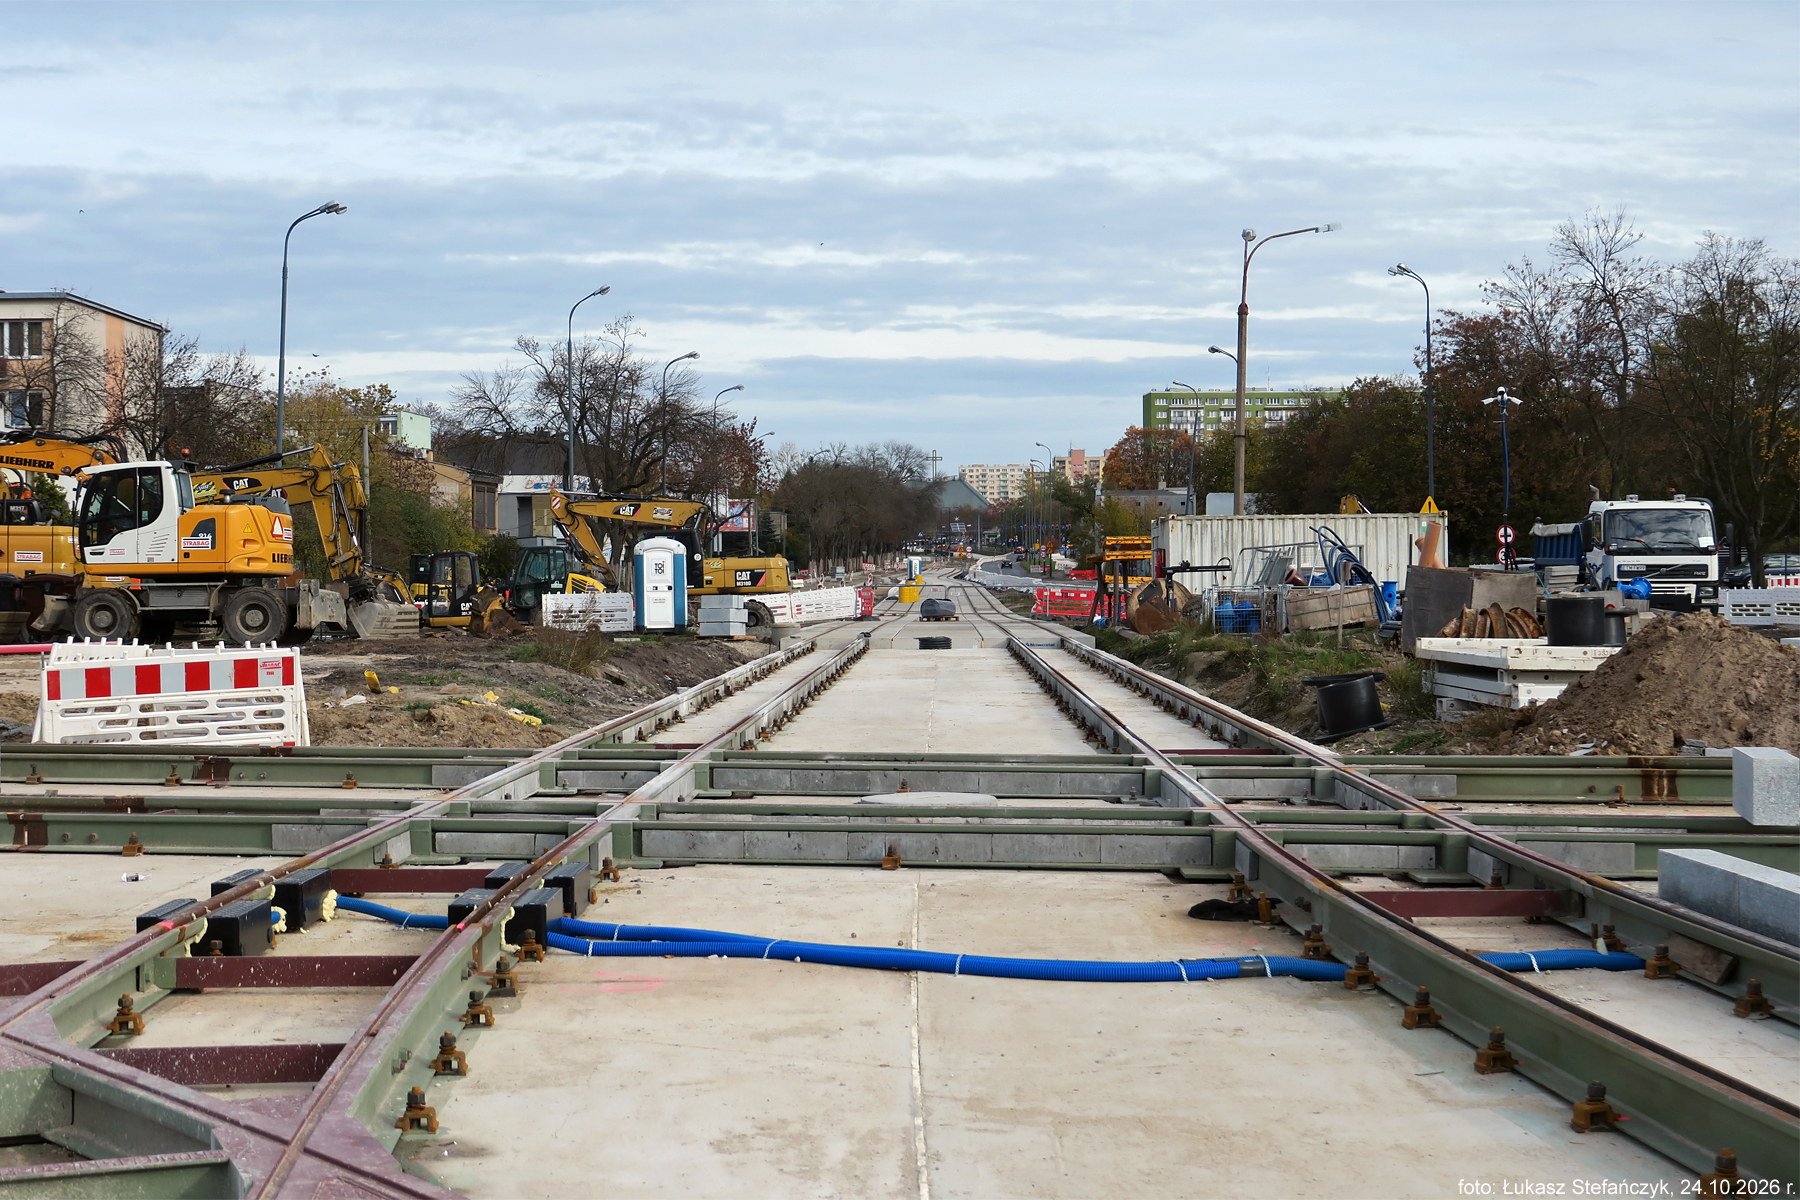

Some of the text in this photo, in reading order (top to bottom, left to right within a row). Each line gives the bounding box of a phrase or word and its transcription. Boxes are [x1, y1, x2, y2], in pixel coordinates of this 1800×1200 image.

[0, 455, 54, 469] LIEBHERR
[233, 478, 249, 490] CAT
[620, 506, 635, 515] CAT
[736, 571, 751, 580] CAT
